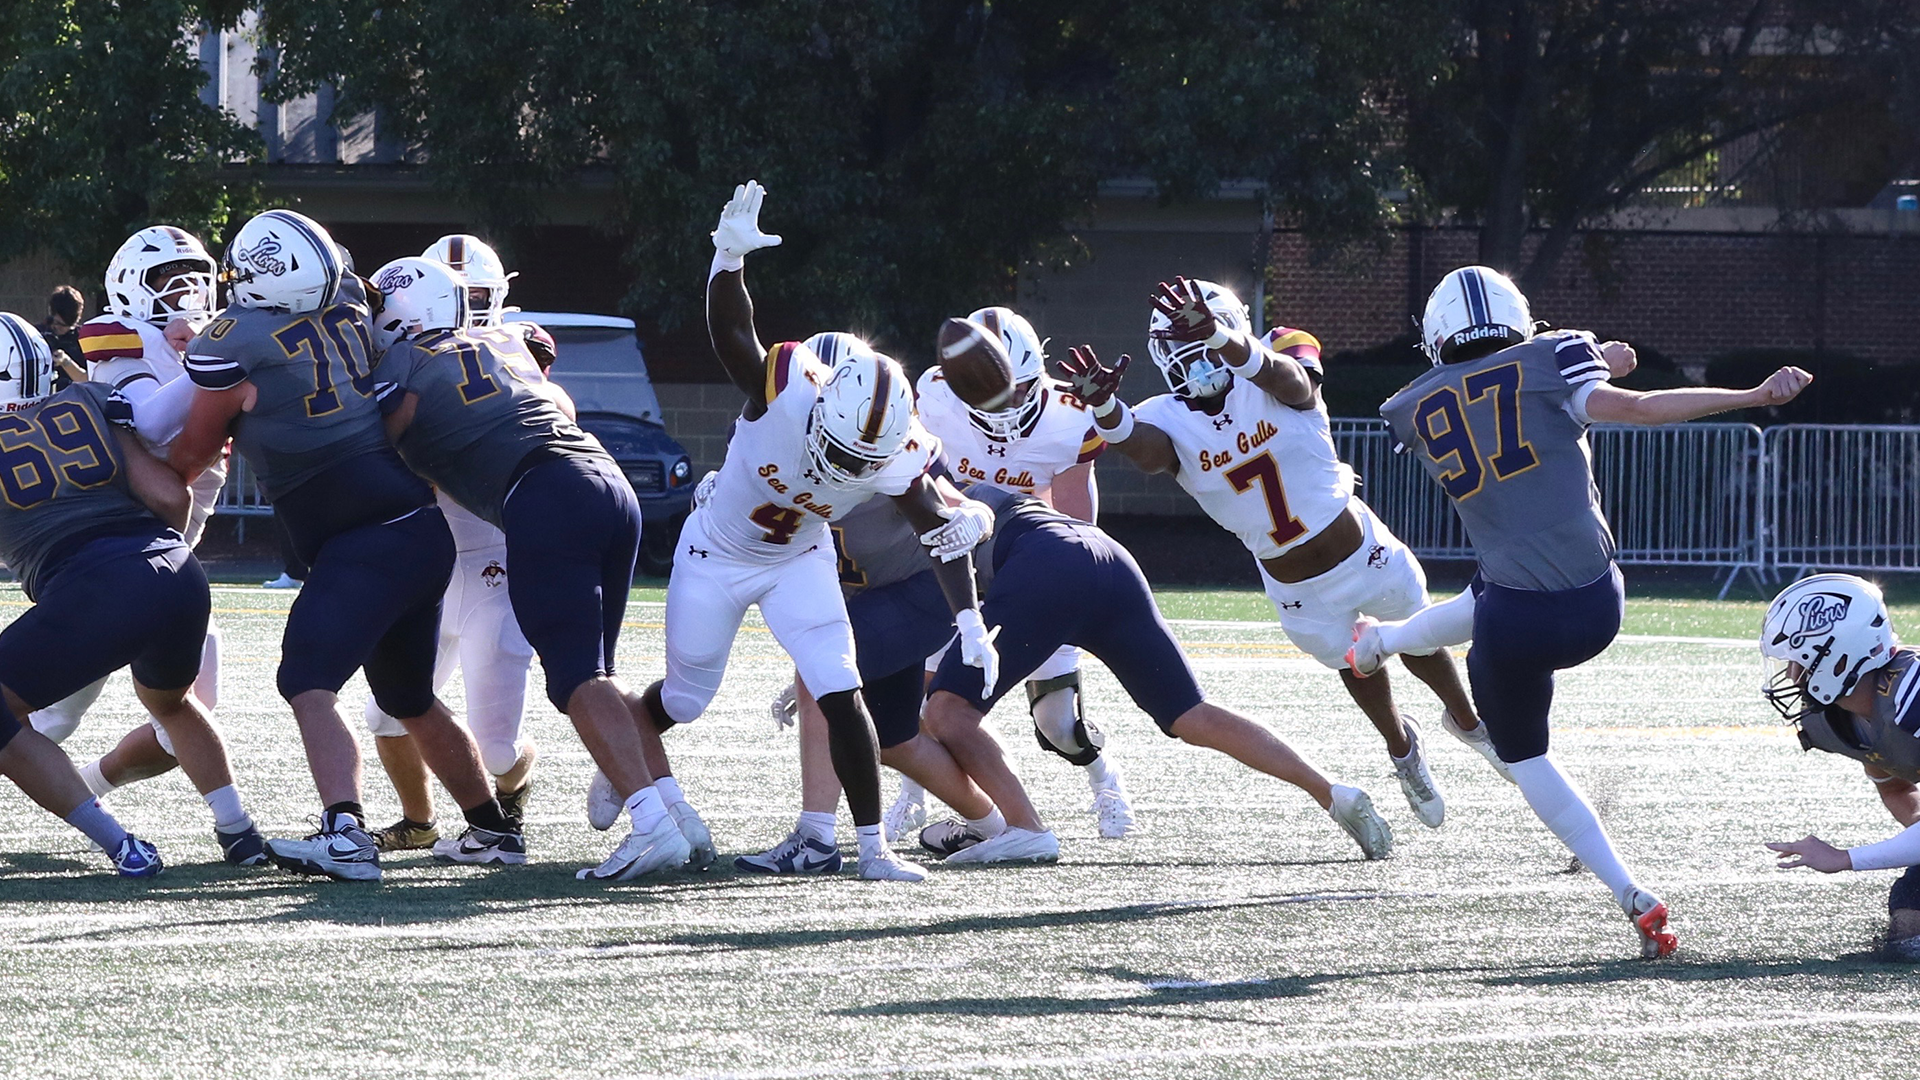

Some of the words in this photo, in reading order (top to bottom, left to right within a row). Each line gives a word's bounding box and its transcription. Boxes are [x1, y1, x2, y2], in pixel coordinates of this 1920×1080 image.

[238, 236, 286, 276] Lions
[271, 302, 376, 418] 70
[1454, 326, 1509, 346] Riddell
[0, 401, 117, 510] 69
[1199, 450, 1233, 472] Sea
[1236, 419, 1278, 454] Gulls
[1413, 361, 1541, 503] 97
[758, 463, 789, 494] Sea
[793, 491, 834, 519] Gulls
[957, 458, 986, 481] Sea
[995, 468, 1035, 488] Gulls
[1222, 448, 1310, 548] 7
[749, 501, 806, 545] 4
[1789, 596, 1847, 649] Lions
